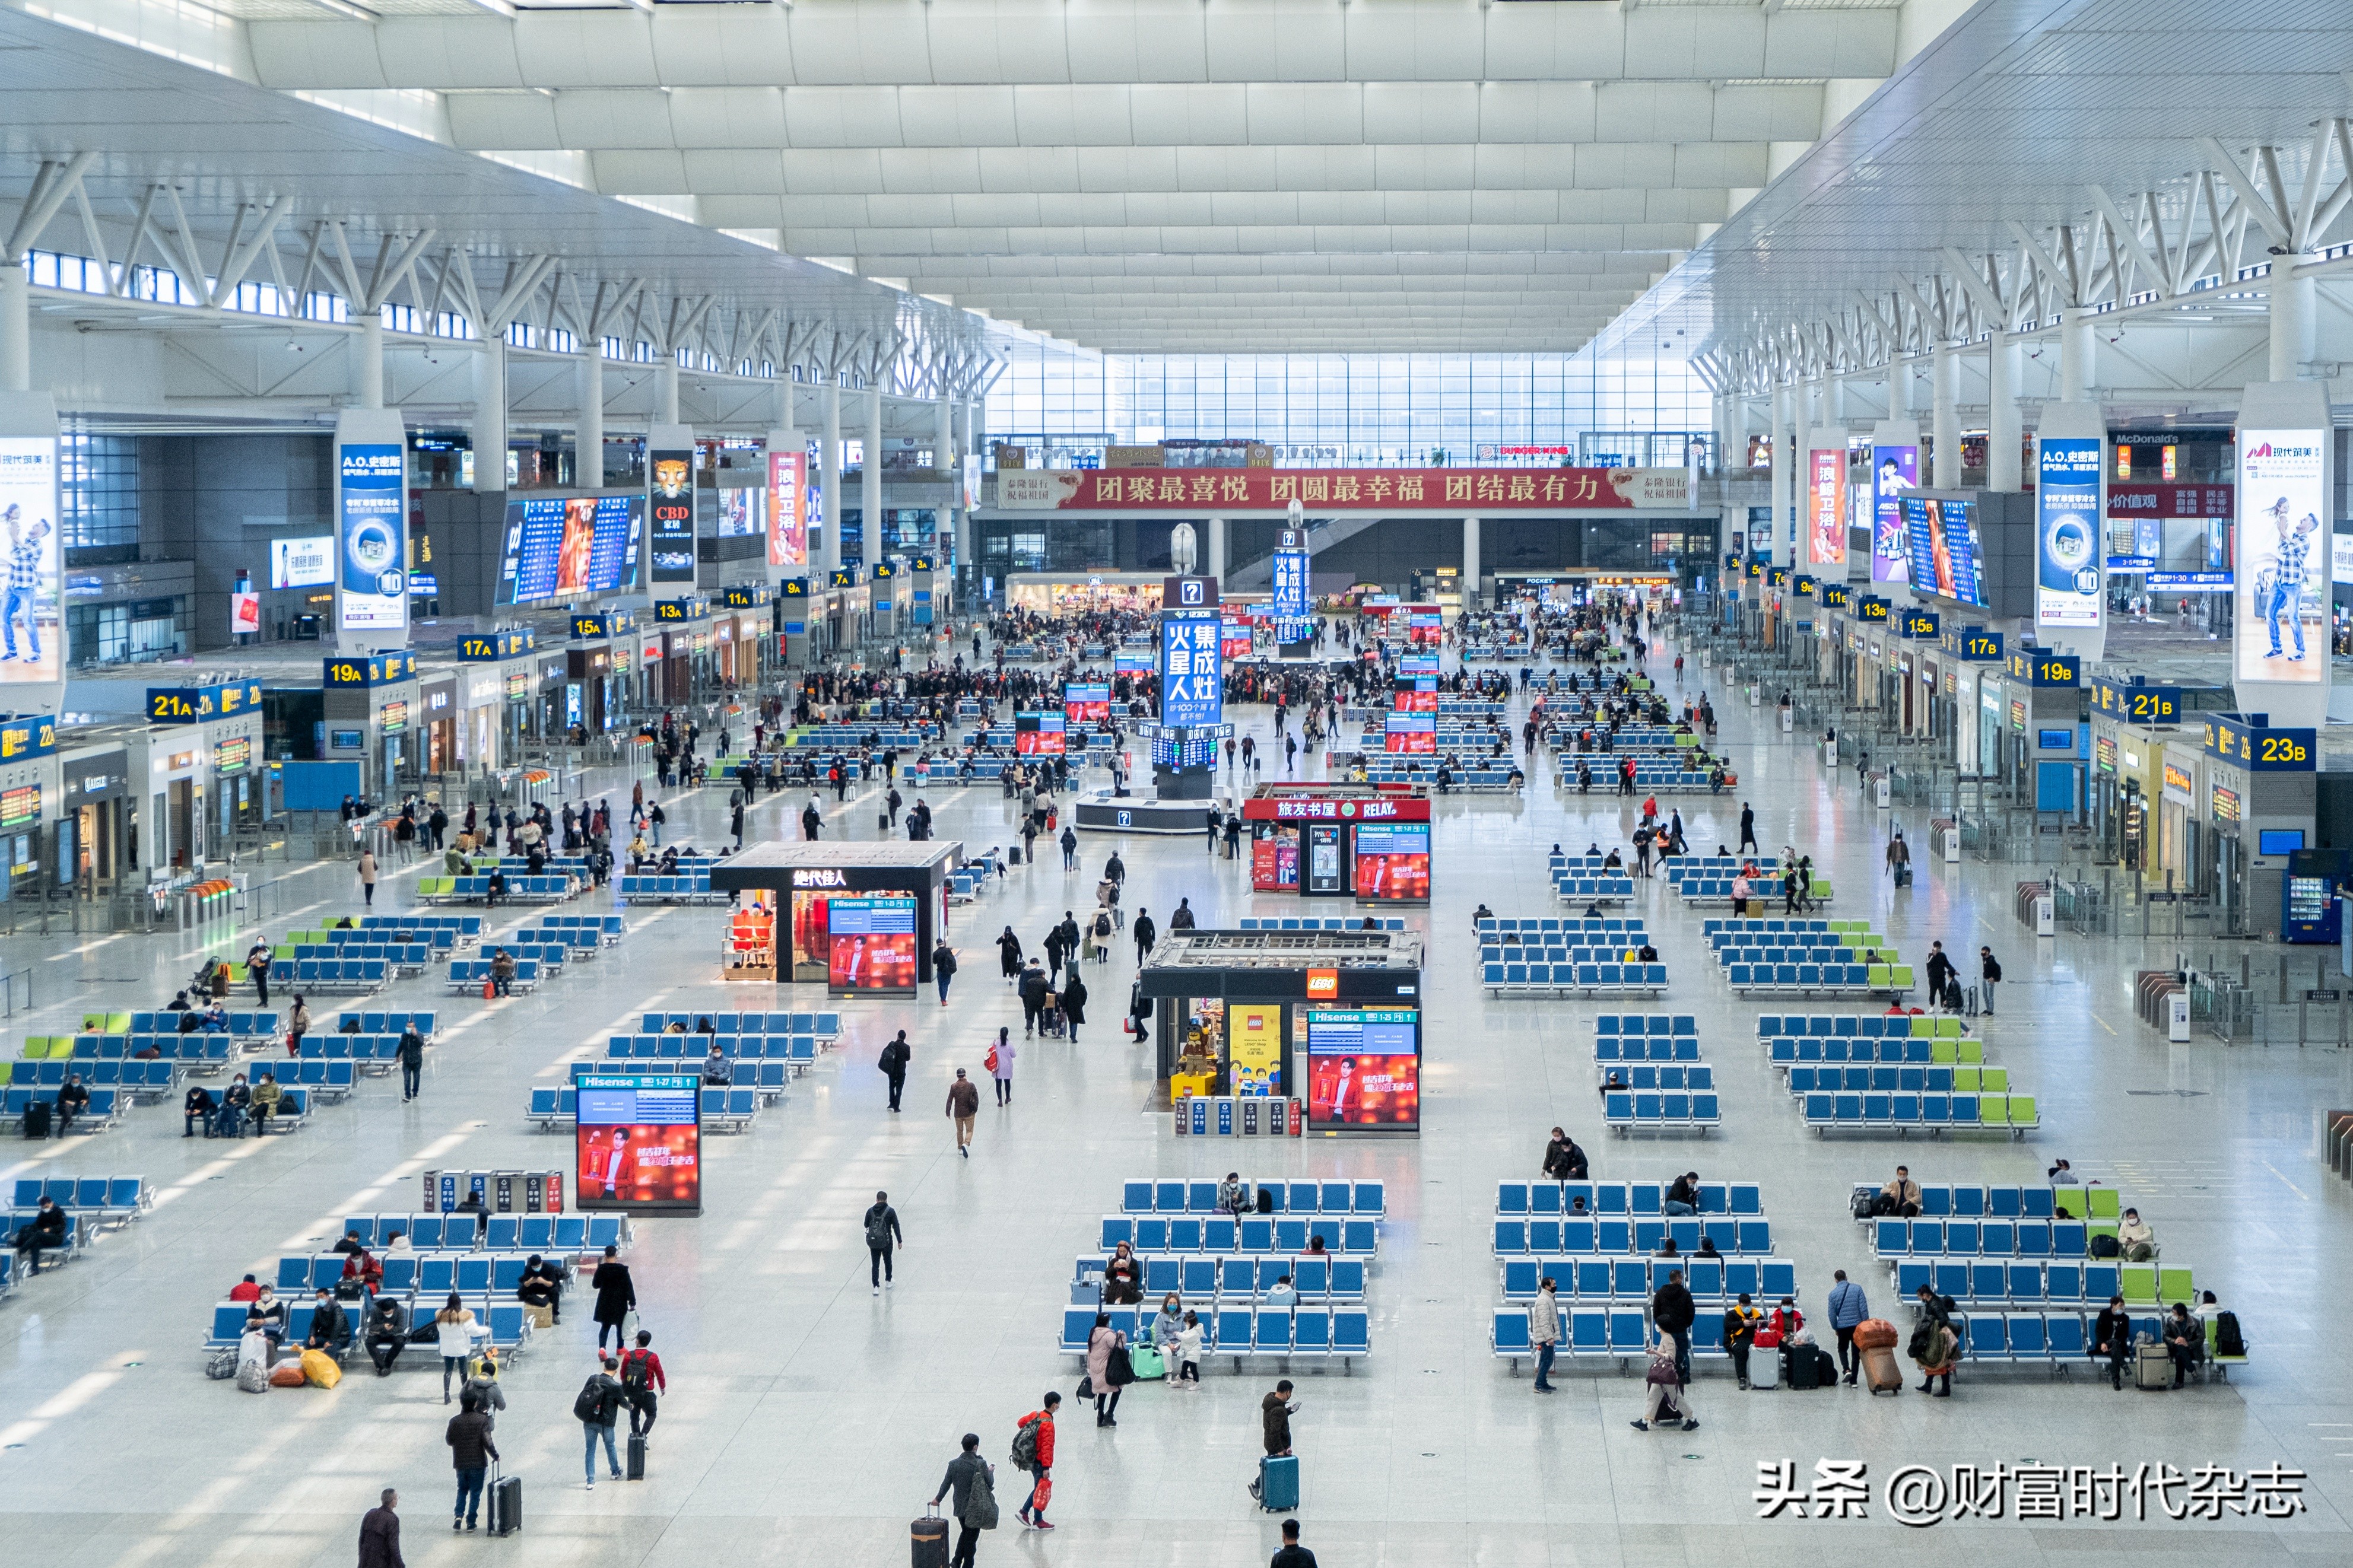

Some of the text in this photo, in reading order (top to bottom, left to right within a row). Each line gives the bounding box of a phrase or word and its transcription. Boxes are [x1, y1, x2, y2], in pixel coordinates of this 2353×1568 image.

[2116, 435, 2179, 443] McDonald's
[1110, 449, 1160, 457] 台湾小吃
[1501, 446, 1542, 454] BURGER
[1544, 446, 1568, 454] KING
[2273, 447, 2312, 457] 现代筑美
[2, 455, 42, 464] 现代筑美
[343, 456, 401, 467] A.O.史密斯
[2042, 451, 2099, 463] A.O.史密斯
[1008, 479, 1048, 489] 泰隆银行
[1644, 477, 1686, 487] 泰隆银行
[1096, 475, 1598, 502] 团聚最喜悦 团圆最幸福 团结最有力
[1644, 488, 1686, 498] 祝福祖国
[778, 469, 795, 529] 浪鲸卫浴
[1008, 490, 1049, 500] 祝福祖国
[1818, 466, 1836, 527] 浪鲸卫浴
[656, 507, 689, 519] CBD
[663, 519, 681, 530] 家居
[917, 560, 927, 569] 3A
[879, 567, 890, 576] 5A
[836, 574, 848, 584] 7A
[1276, 556, 1288, 602] 火星人
[1288, 556, 1301, 602] 集成灶
[787, 583, 801, 594] 9A
[1801, 582, 1813, 592] 9B
[729, 593, 748, 605] 11A
[1828, 591, 1846, 603] 11B
[659, 605, 682, 618] 13A
[1864, 604, 1887, 616] 13B
[576, 620, 601, 634] 15A
[1909, 619, 1933, 632] 15B
[463, 640, 492, 656] 17A
[1968, 638, 1996, 654] 17B
[1168, 625, 1190, 701] 火星人
[1193, 625, 1217, 701] 集成灶
[331, 664, 362, 682] 19A
[2041, 663, 2072, 680] 19B
[250, 685, 261, 705] 20A
[154, 695, 192, 716] 21A
[2134, 695, 2173, 715] 21B
[40, 725, 55, 748] 22A
[2241, 736, 2251, 761] 23B
[2262, 738, 2306, 761] 23B
[1278, 802, 1336, 817] 旅友书屋
[1364, 802, 1393, 818] RELAY
[793, 870, 847, 886] 绝代佳人
[1310, 978, 1335, 990] LEGO
[1315, 1013, 1360, 1022] Hisense
[585, 1077, 634, 1086] Hisense
